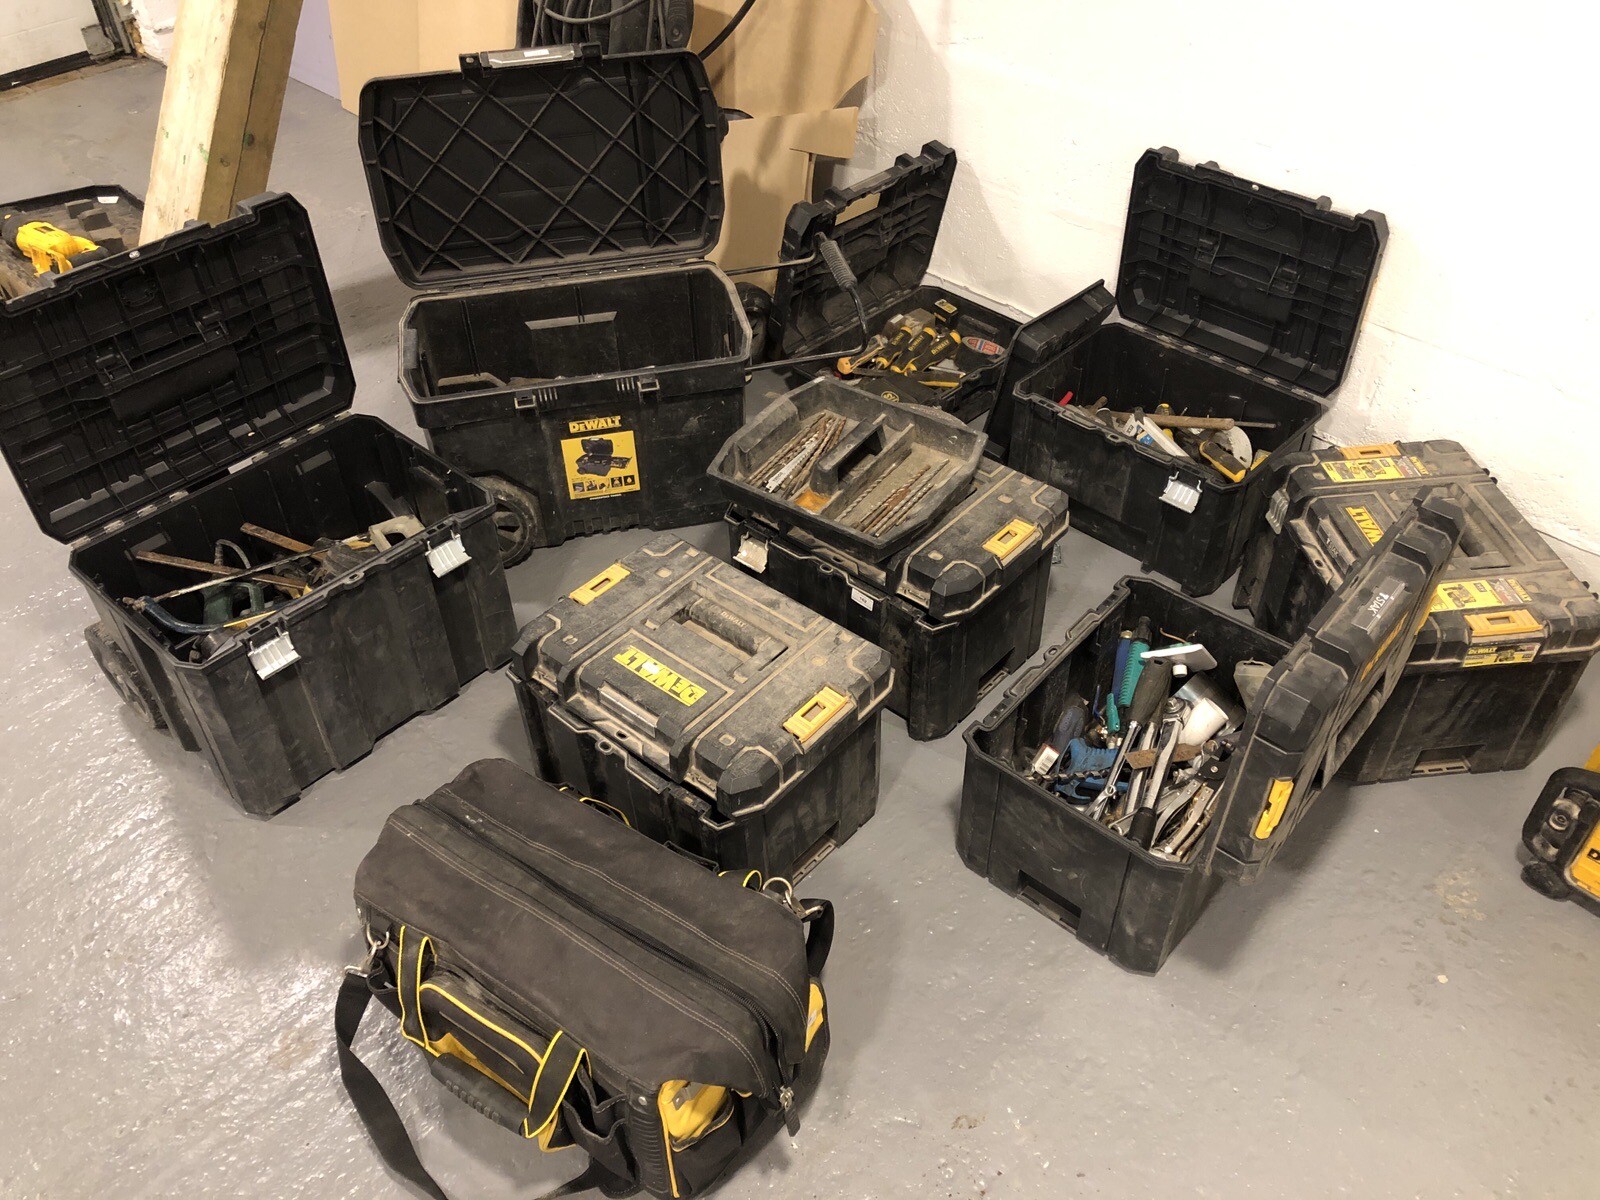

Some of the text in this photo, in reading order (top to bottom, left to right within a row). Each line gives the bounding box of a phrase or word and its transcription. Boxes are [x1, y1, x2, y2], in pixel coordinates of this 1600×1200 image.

[931, 340, 949, 355] DEWALT
[568, 416, 621, 433] DEWALT
[1346, 506, 1383, 546] WALT
[1367, 592, 1390, 614] TSTAK
[615, 647, 706, 705] DEWALT
